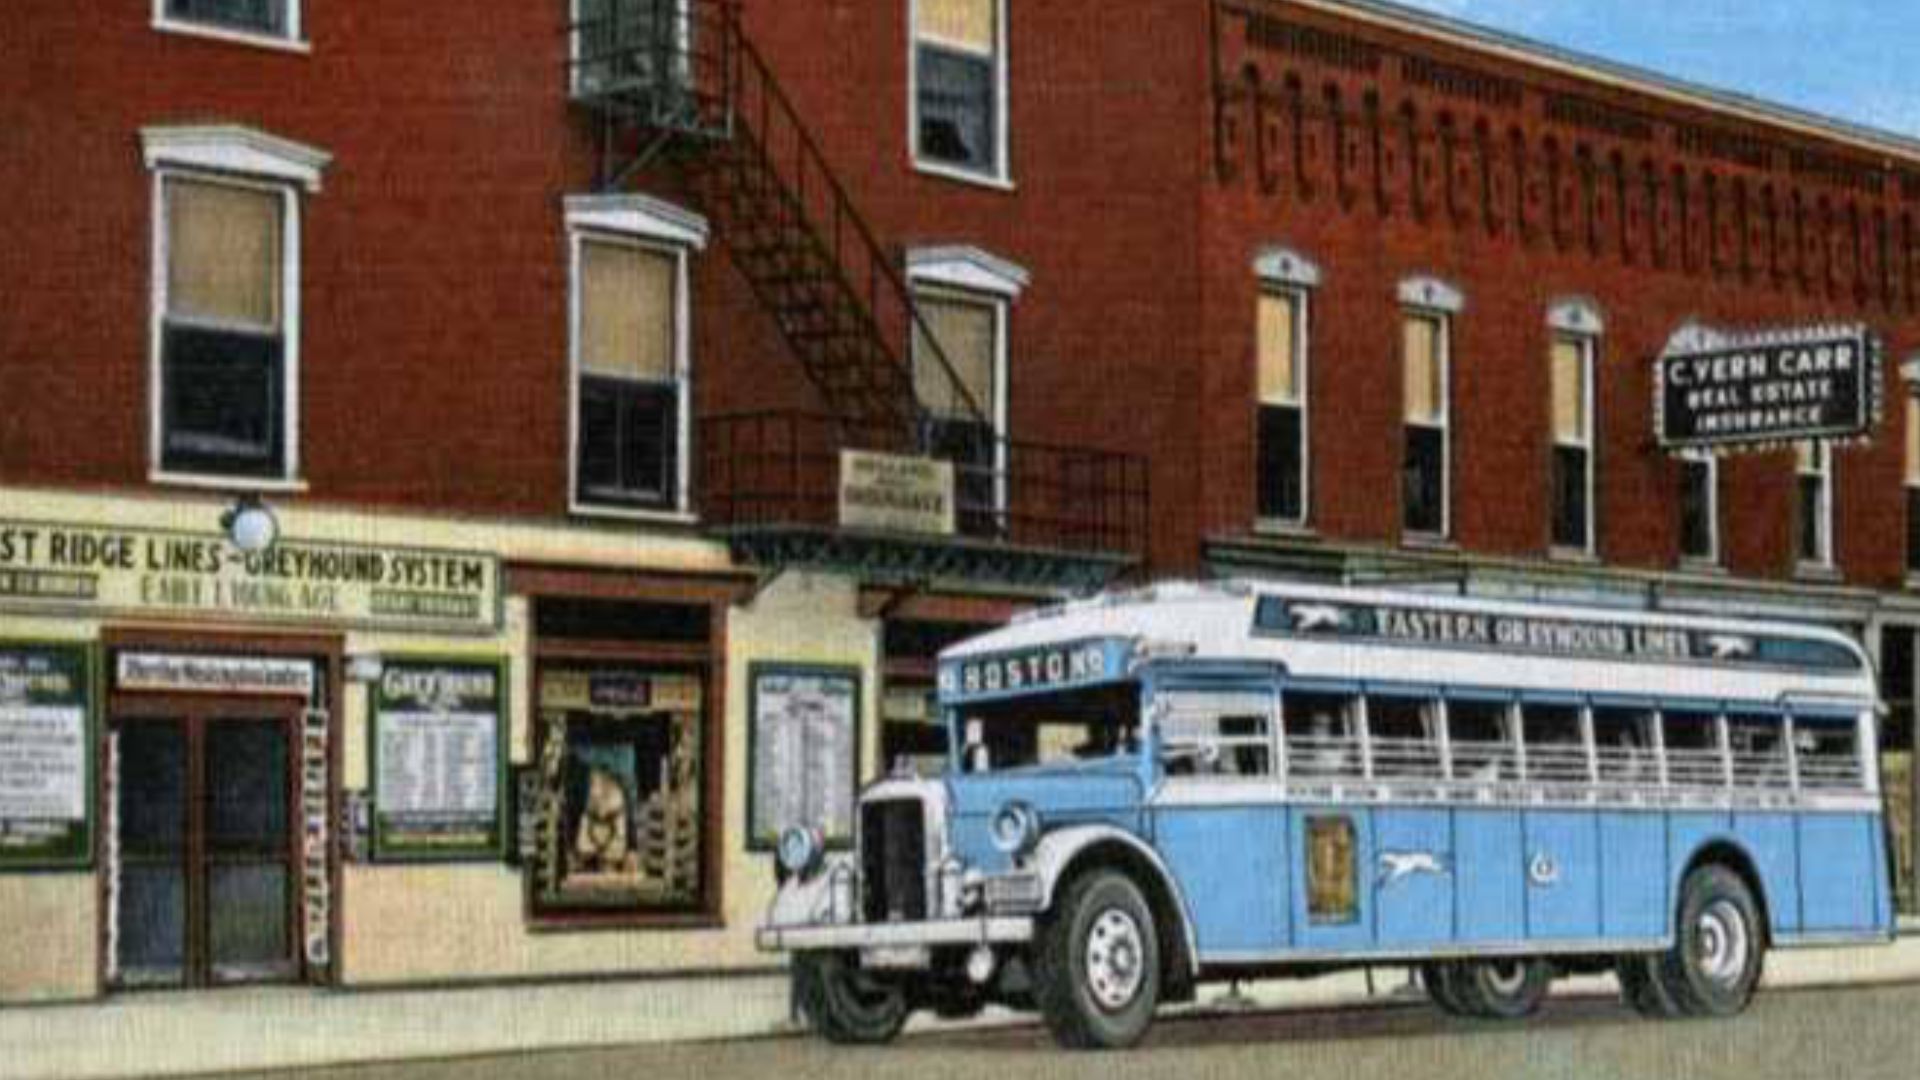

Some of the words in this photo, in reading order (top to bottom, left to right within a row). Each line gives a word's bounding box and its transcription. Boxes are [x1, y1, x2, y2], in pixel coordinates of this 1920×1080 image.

[1778, 345, 1852, 374] CARR
[1687, 384, 1740, 409] REAL
[1751, 378, 1832, 402] ESTATE
[1696, 404, 1822, 431] INSURANCE
[50, 531, 136, 569] RIDGE
[390, 555, 484, 590] SYSTEM
[1376, 607, 1487, 642] EASTERN
[1496, 619, 1626, 653] GREYHOUND
